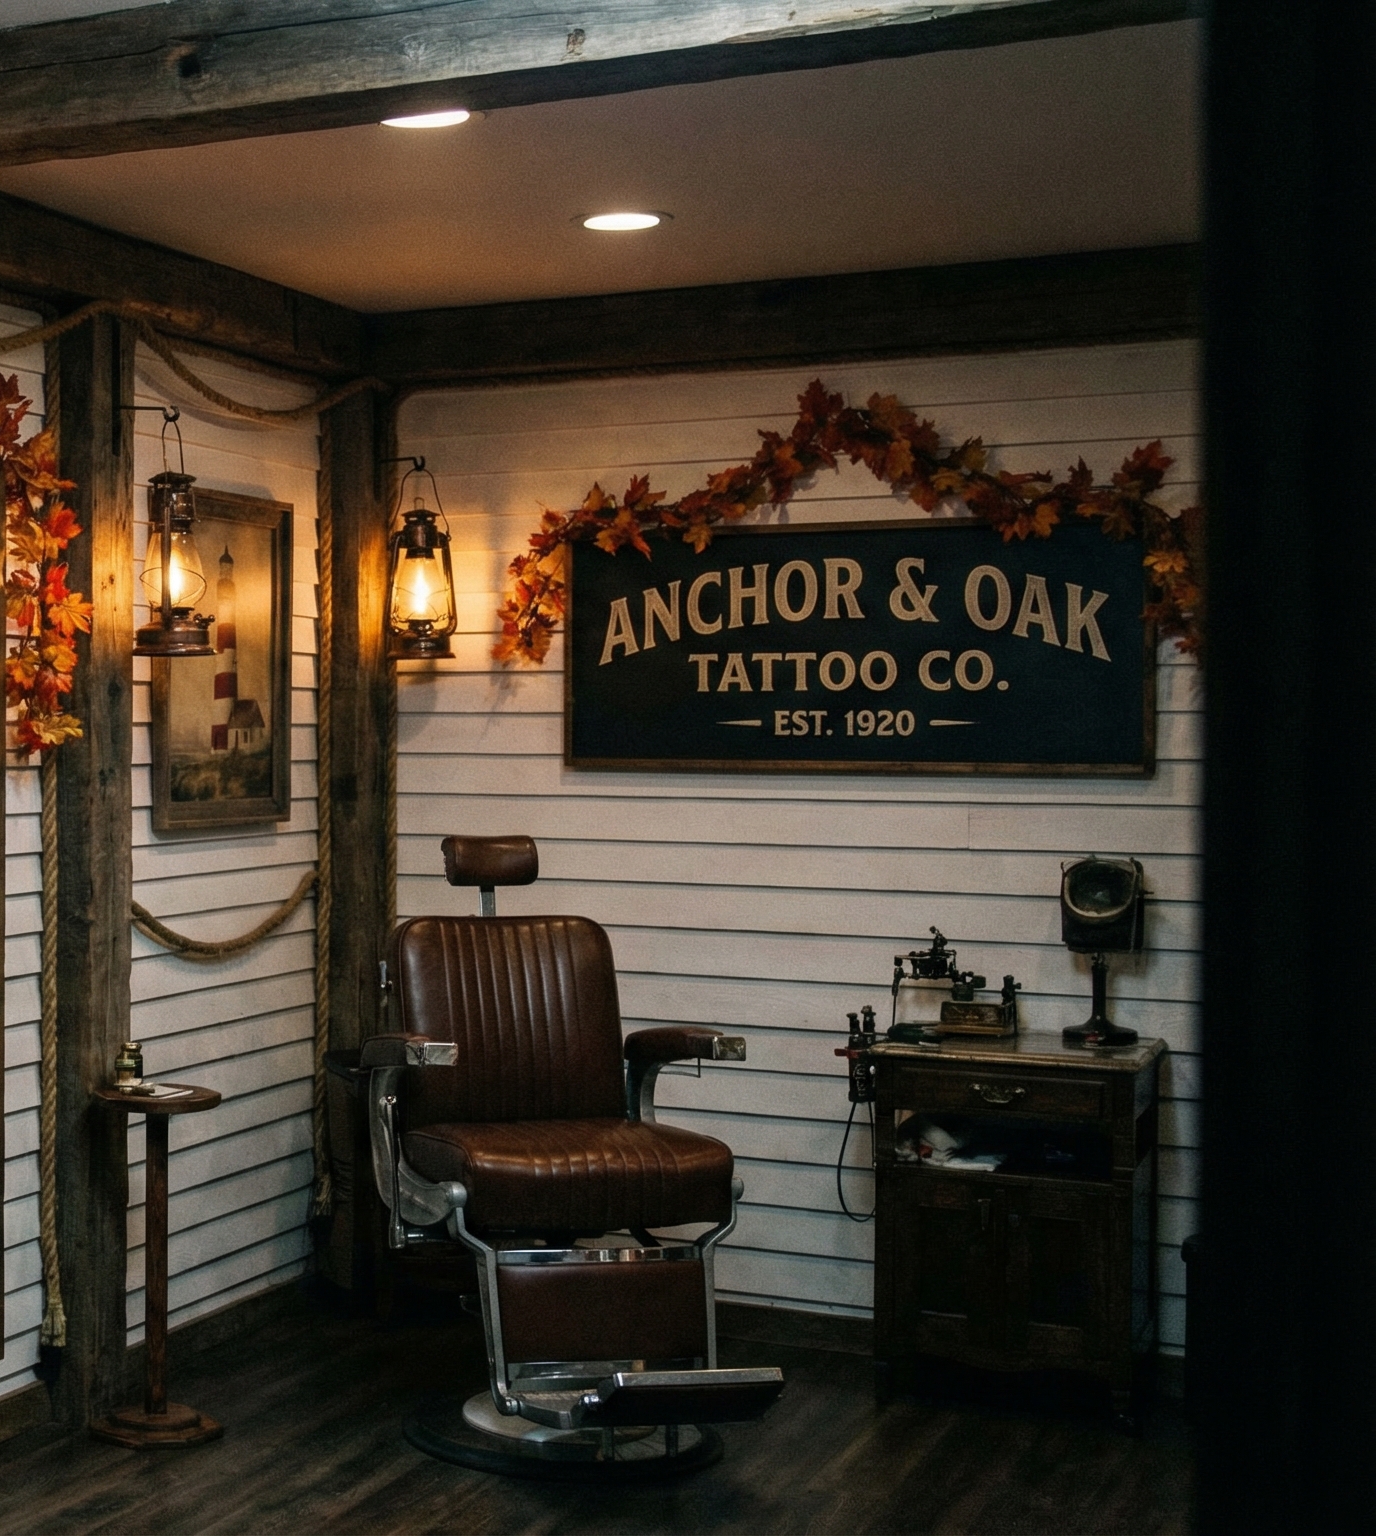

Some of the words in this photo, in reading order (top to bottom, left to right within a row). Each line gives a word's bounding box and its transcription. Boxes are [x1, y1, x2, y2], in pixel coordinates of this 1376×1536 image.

[598, 557, 866, 666] ANCHOR
[889, 557, 940, 623] &
[964, 564, 1112, 662] OAK
[688, 650, 898, 692] TATTOO
[918, 649, 1010, 691] CO.
[774, 709, 834, 736] EST.
[844, 709, 915, 737] 1920
